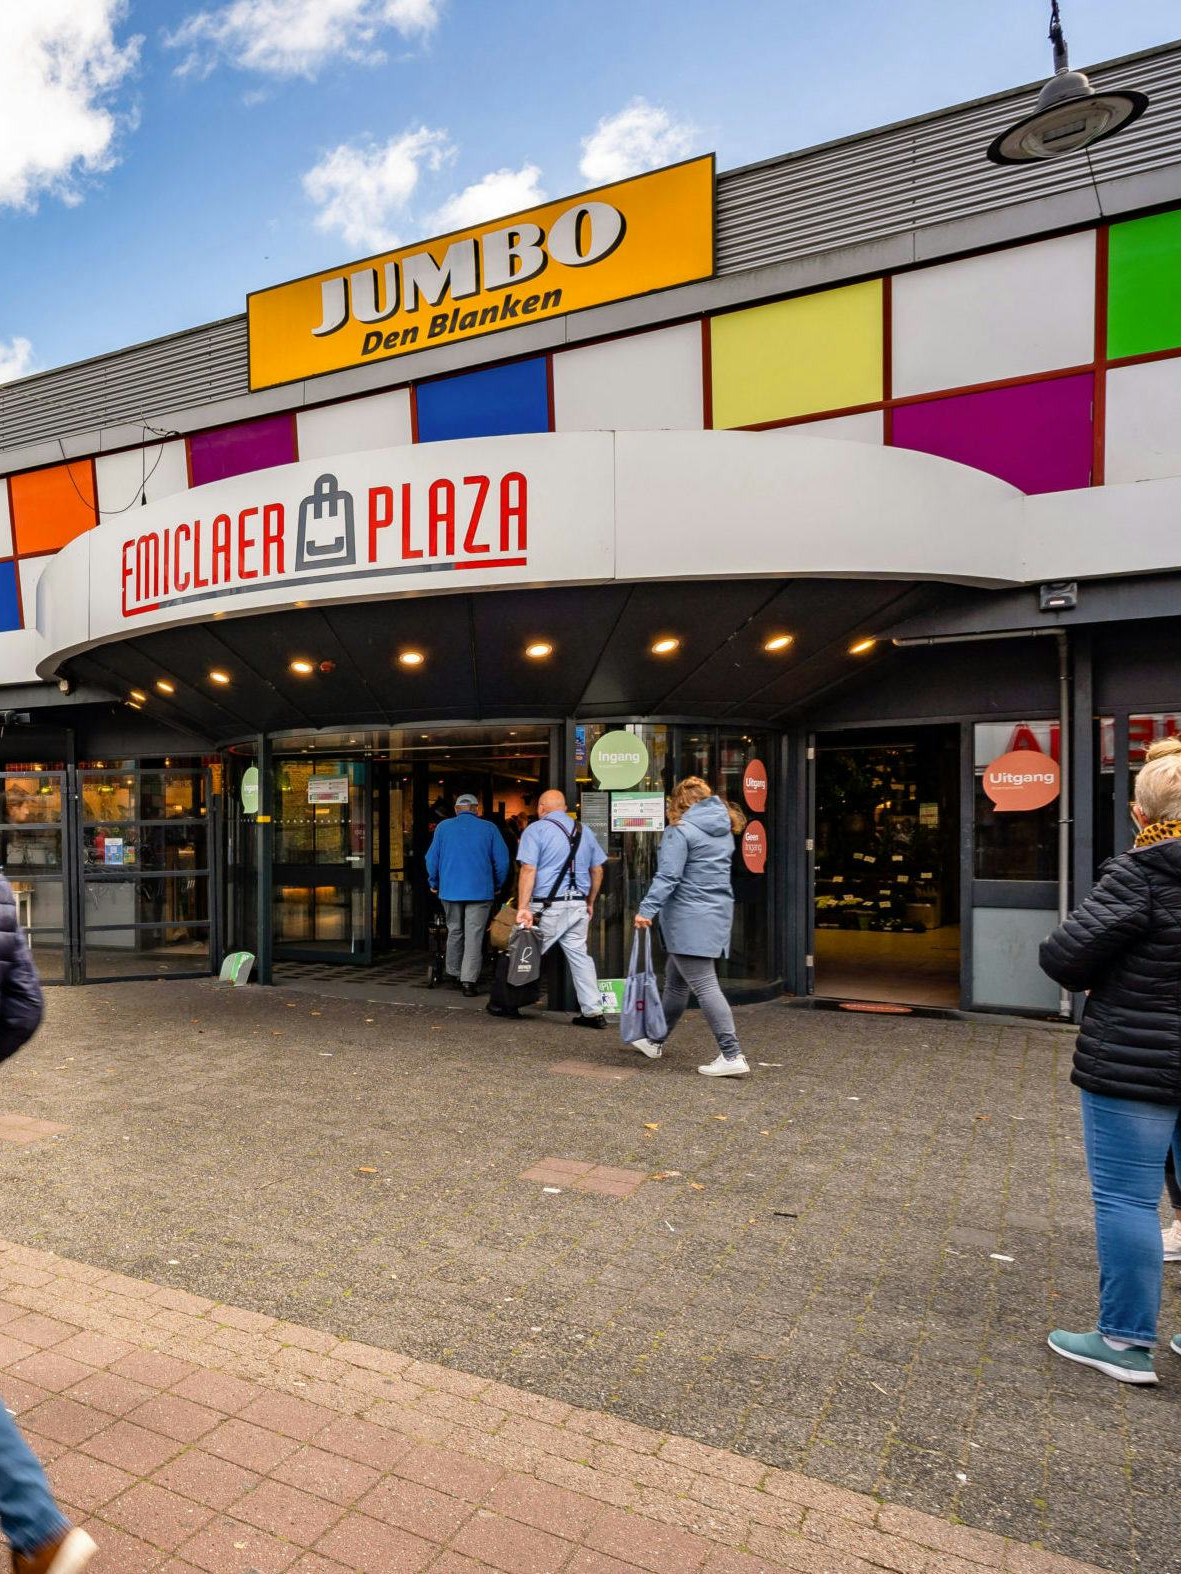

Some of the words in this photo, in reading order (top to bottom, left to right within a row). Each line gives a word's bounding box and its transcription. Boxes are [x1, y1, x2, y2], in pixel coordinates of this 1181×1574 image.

[311, 202, 626, 336] JUMBO
[361, 327, 418, 356] Den
[427, 287, 563, 339] Blanken
[122, 502, 286, 614] EMICLAER
[368, 471, 528, 563] PLAZA
[598, 751, 640, 764] Ingang
[746, 778, 766, 790] Uitgang
[989, 772, 1055, 786] Uitgang
[745, 833, 759, 842] Geen
[745, 843, 763, 854] Ingang
